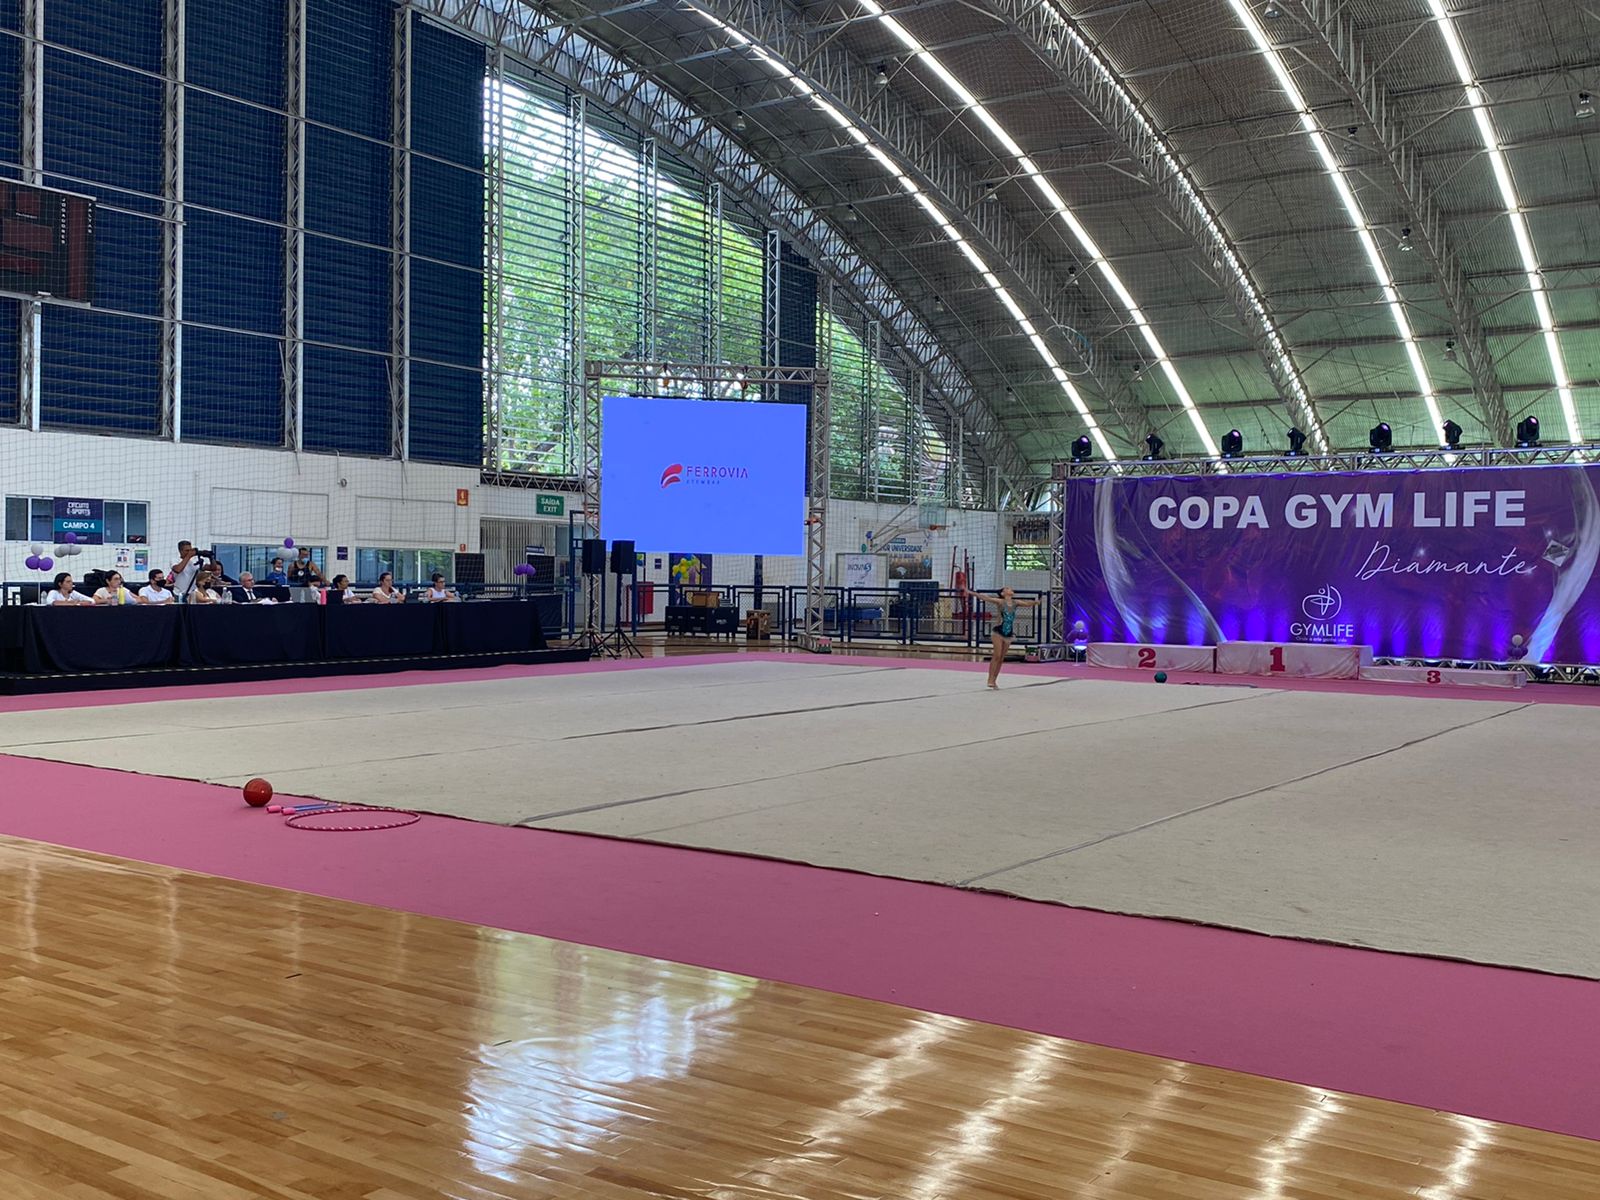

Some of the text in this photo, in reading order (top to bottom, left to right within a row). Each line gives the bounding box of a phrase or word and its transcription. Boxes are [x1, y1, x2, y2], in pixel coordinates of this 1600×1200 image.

[686, 466, 748, 478] FERROVIA
[541, 497, 560, 506] SAÍDA
[1149, 490, 1526, 530] COPA GYM LIFE
[1355, 541, 1537, 581] Diamante
[1290, 622, 1354, 637] GYMLIFE
[1138, 648, 1157, 668] 2
[1269, 646, 1286, 672] 1
[1427, 670, 1441, 683] 3
